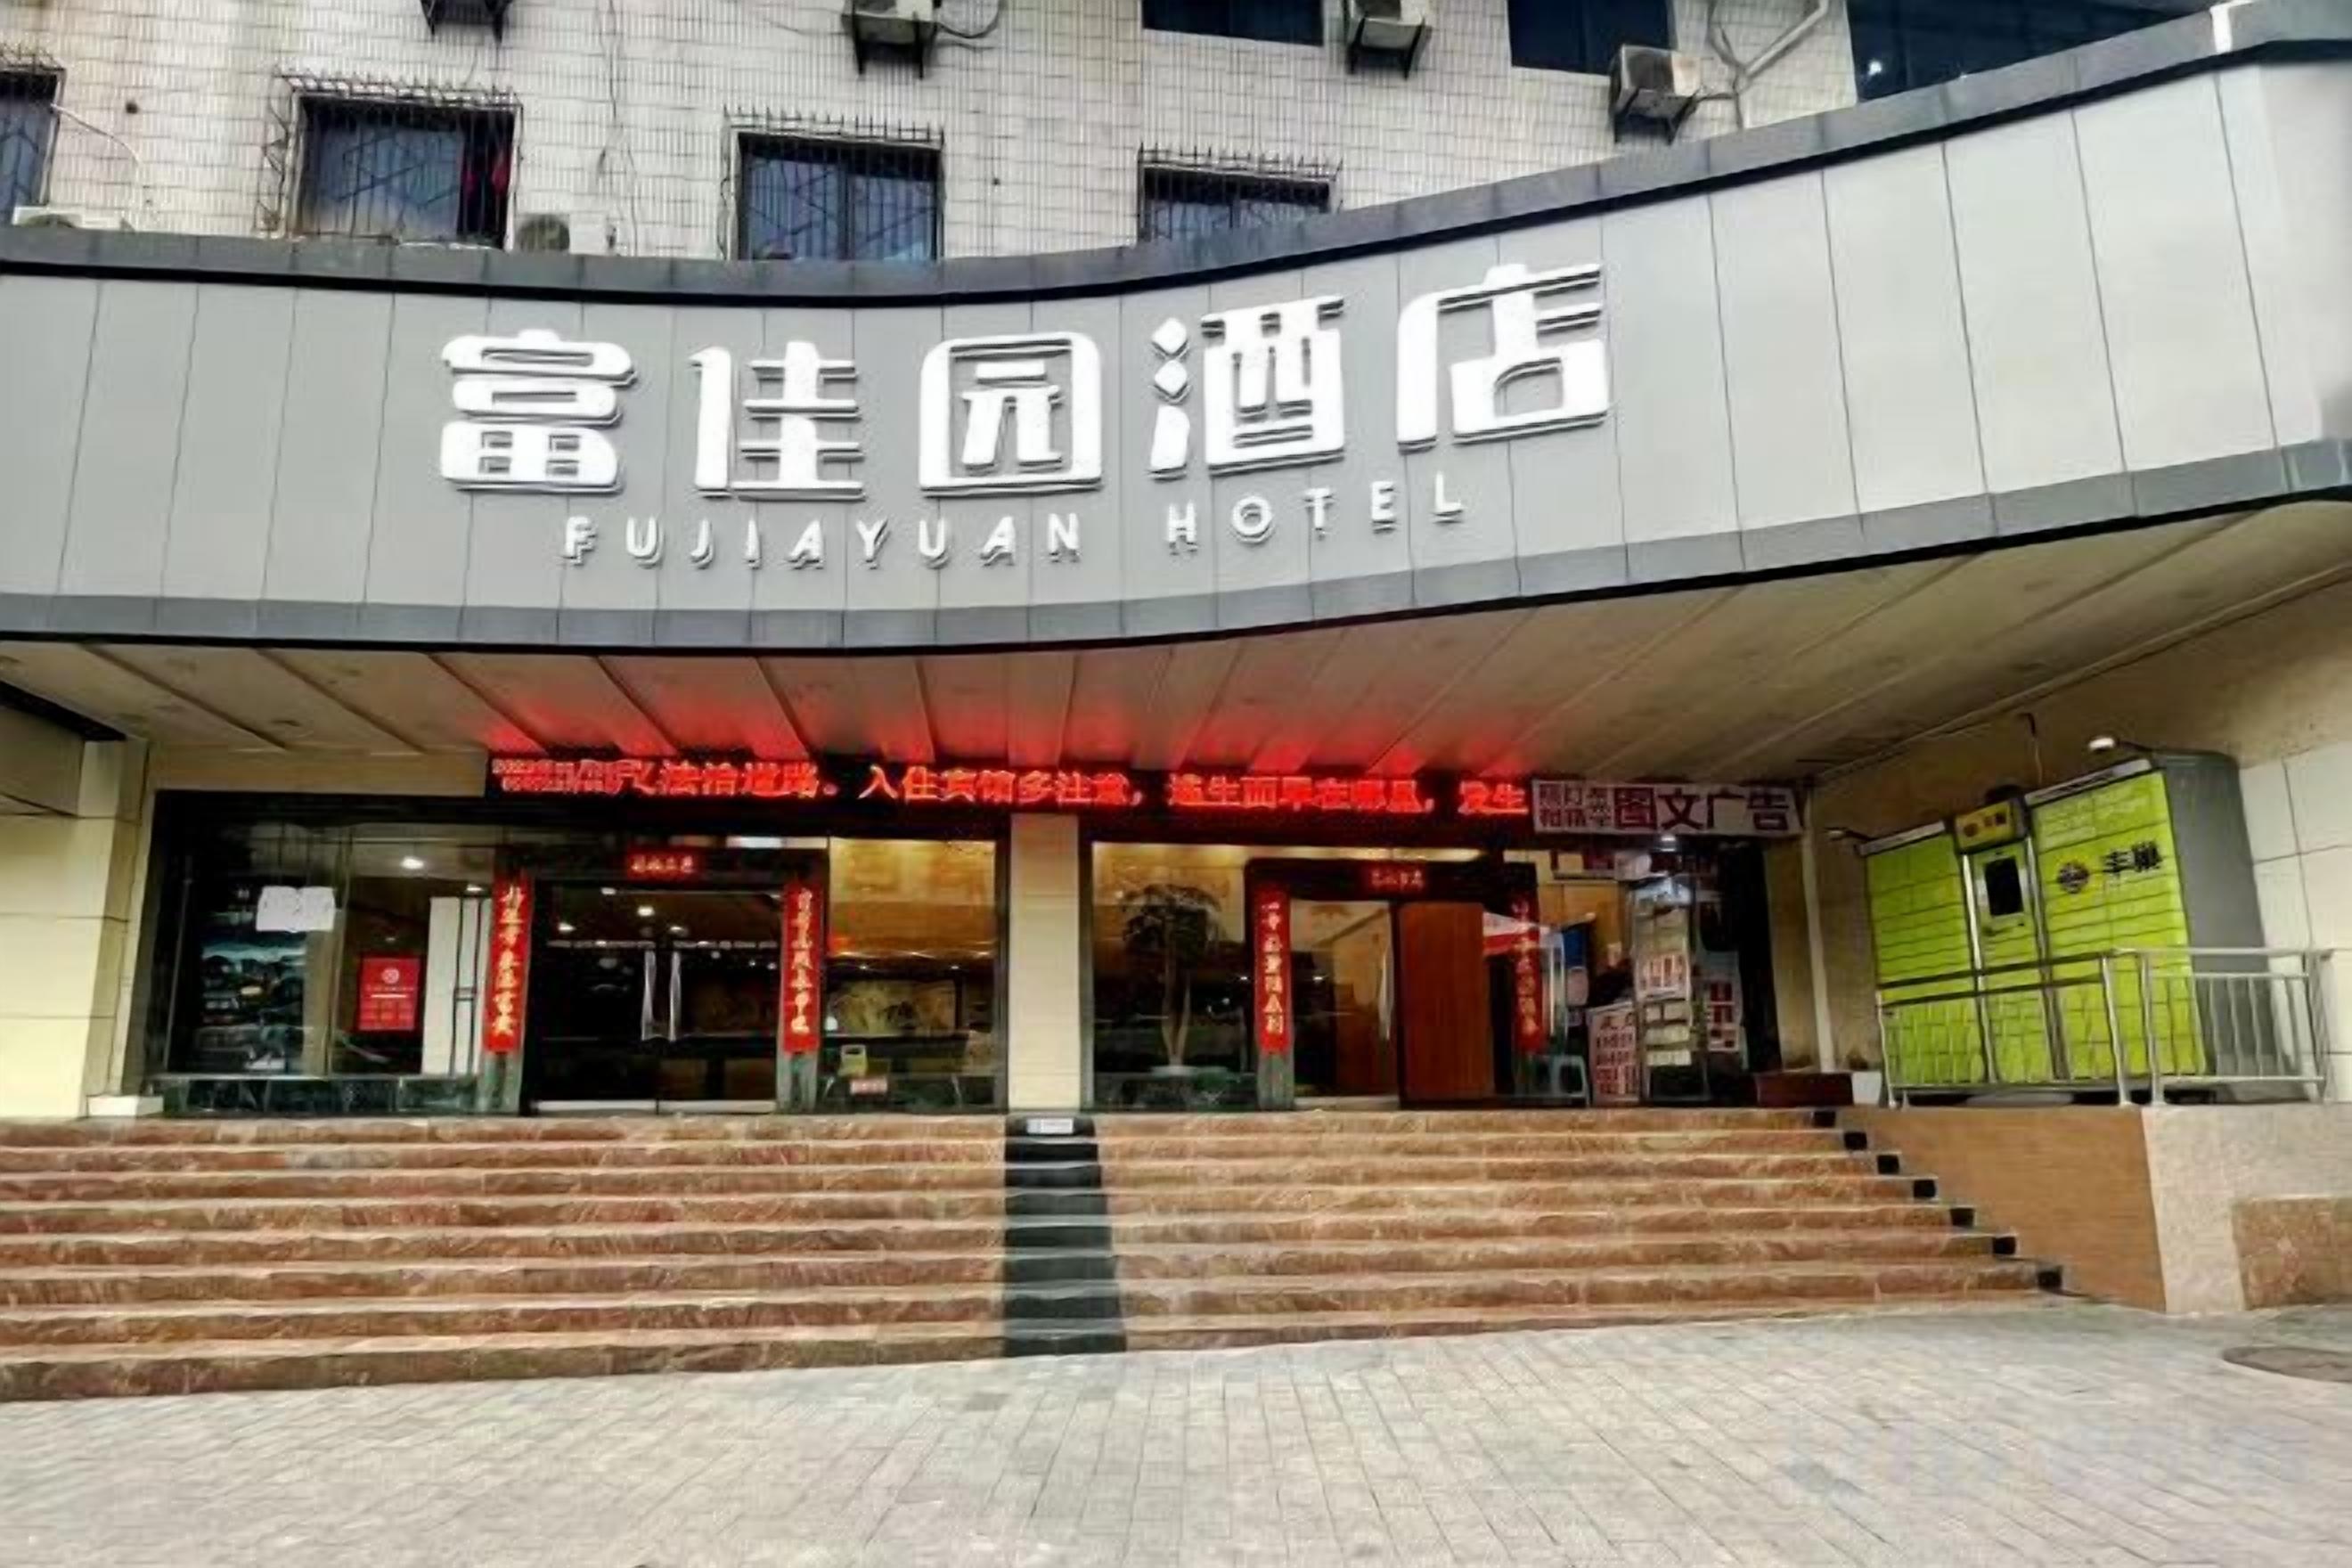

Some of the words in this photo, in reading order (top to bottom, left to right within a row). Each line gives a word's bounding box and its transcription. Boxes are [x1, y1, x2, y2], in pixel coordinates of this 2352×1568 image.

[440, 264, 1611, 501] 富佳园酒店
[562, 510, 1082, 570] FUJIAYUAN
[1164, 471, 1463, 556] HOTEL
[1613, 786, 1791, 831] 图文广告
